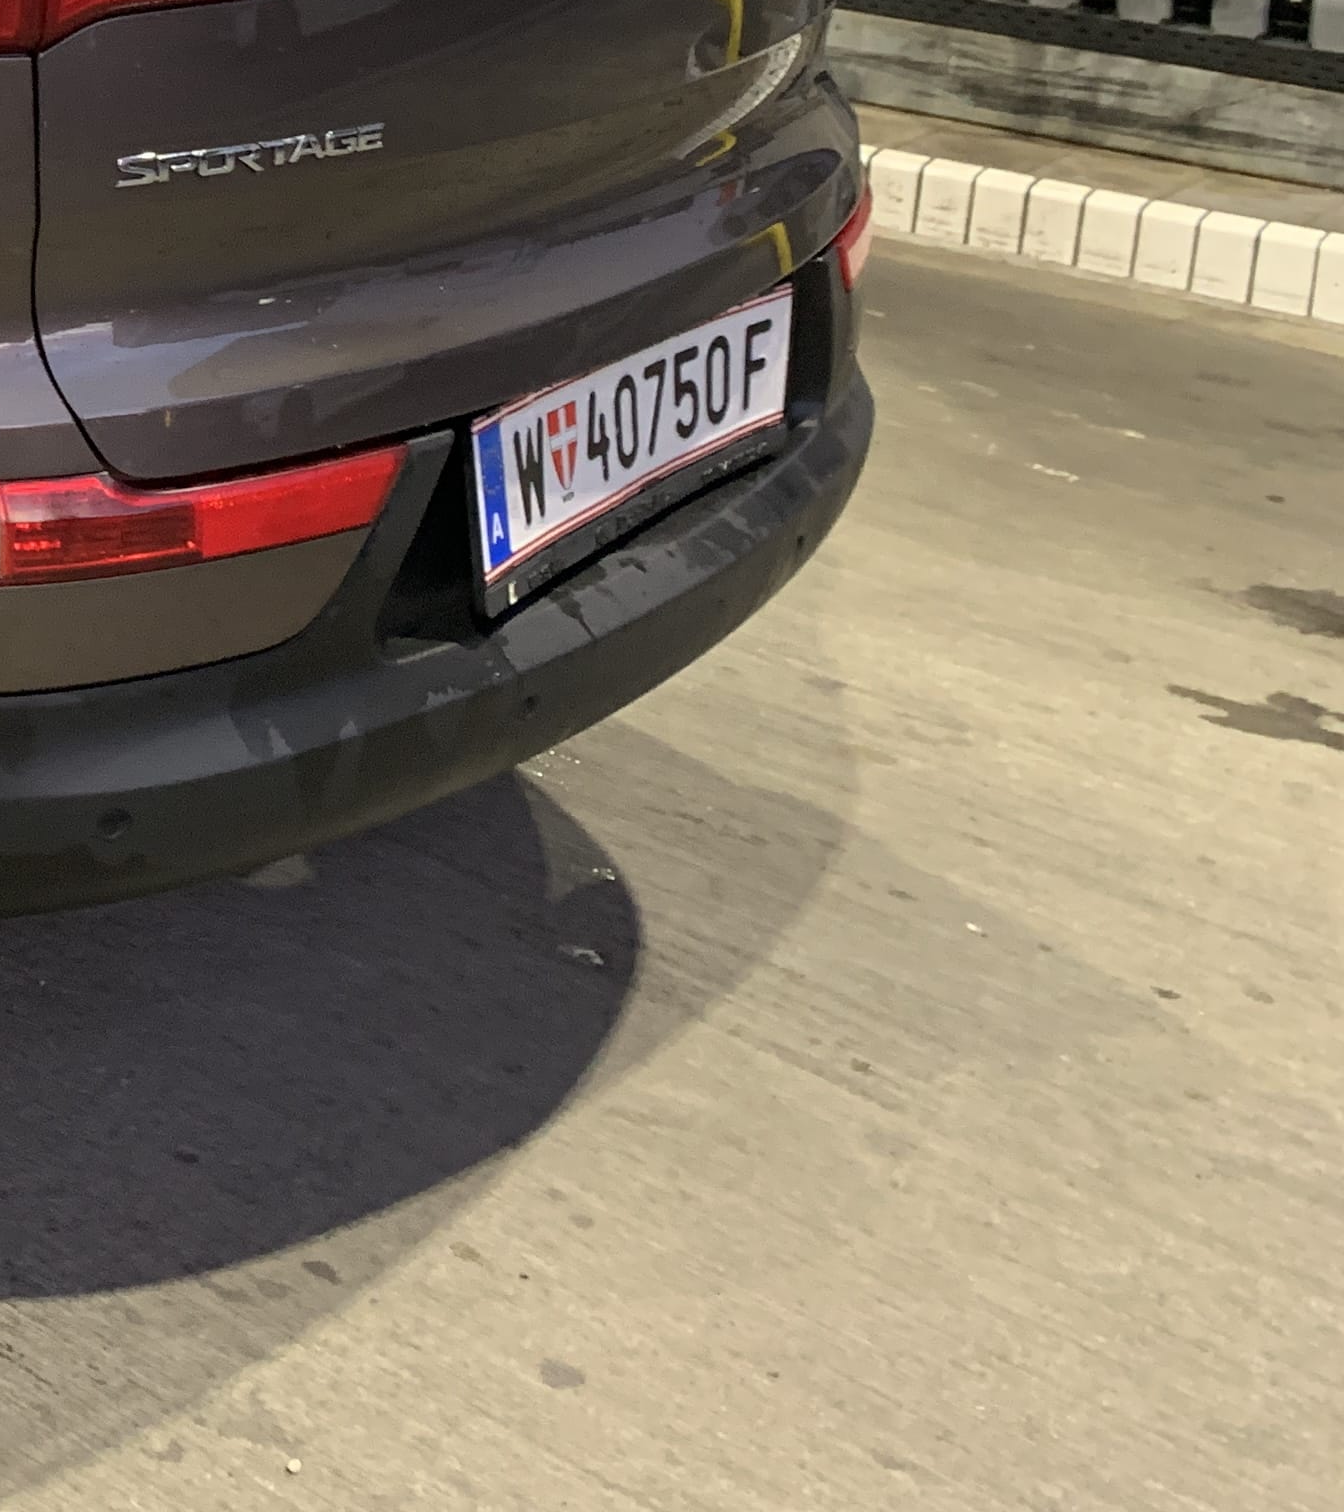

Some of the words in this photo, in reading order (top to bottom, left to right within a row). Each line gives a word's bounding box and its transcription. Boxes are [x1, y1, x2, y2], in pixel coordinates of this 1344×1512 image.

[115, 122, 385, 188] SPORTAGE
[514, 417, 546, 527] W
[491, 514, 505, 545] A
